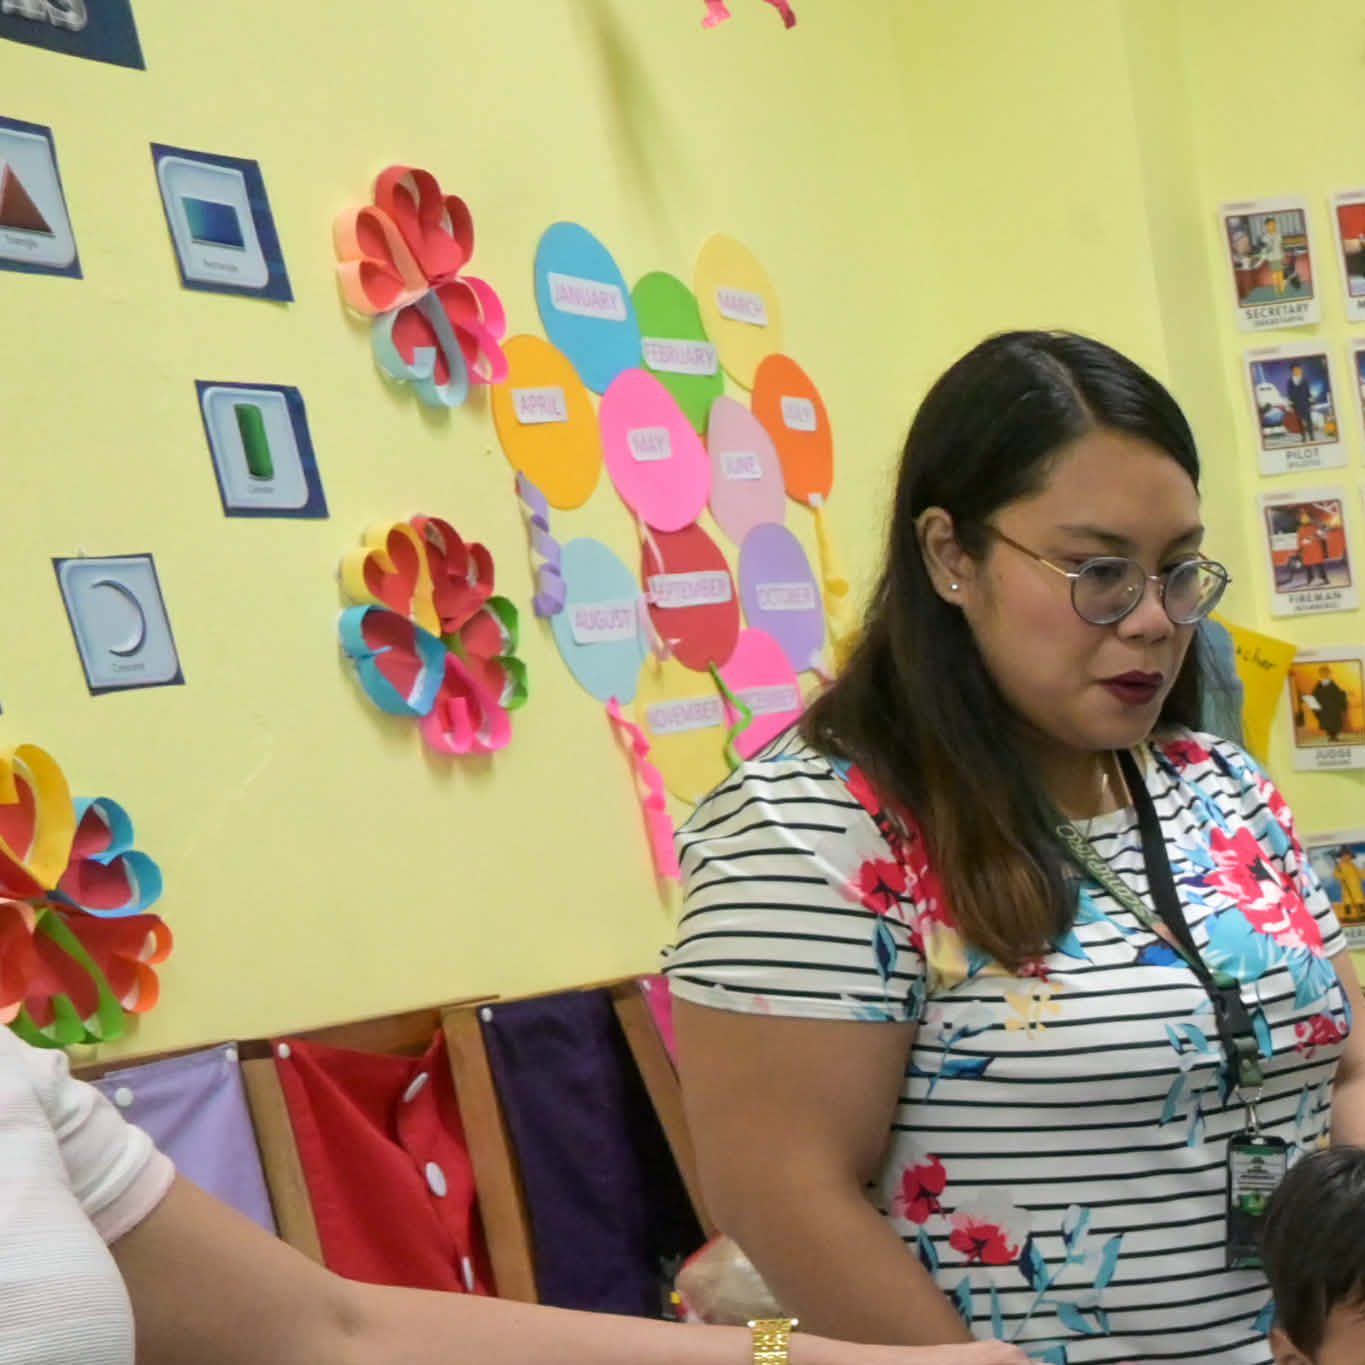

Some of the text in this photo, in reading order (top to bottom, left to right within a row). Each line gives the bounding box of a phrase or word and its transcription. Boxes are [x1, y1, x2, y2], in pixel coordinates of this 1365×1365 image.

[555, 285, 619, 314] JANUARY
[644, 342, 715, 372] FEBRUARY
[575, 608, 632, 632] AUGUST
